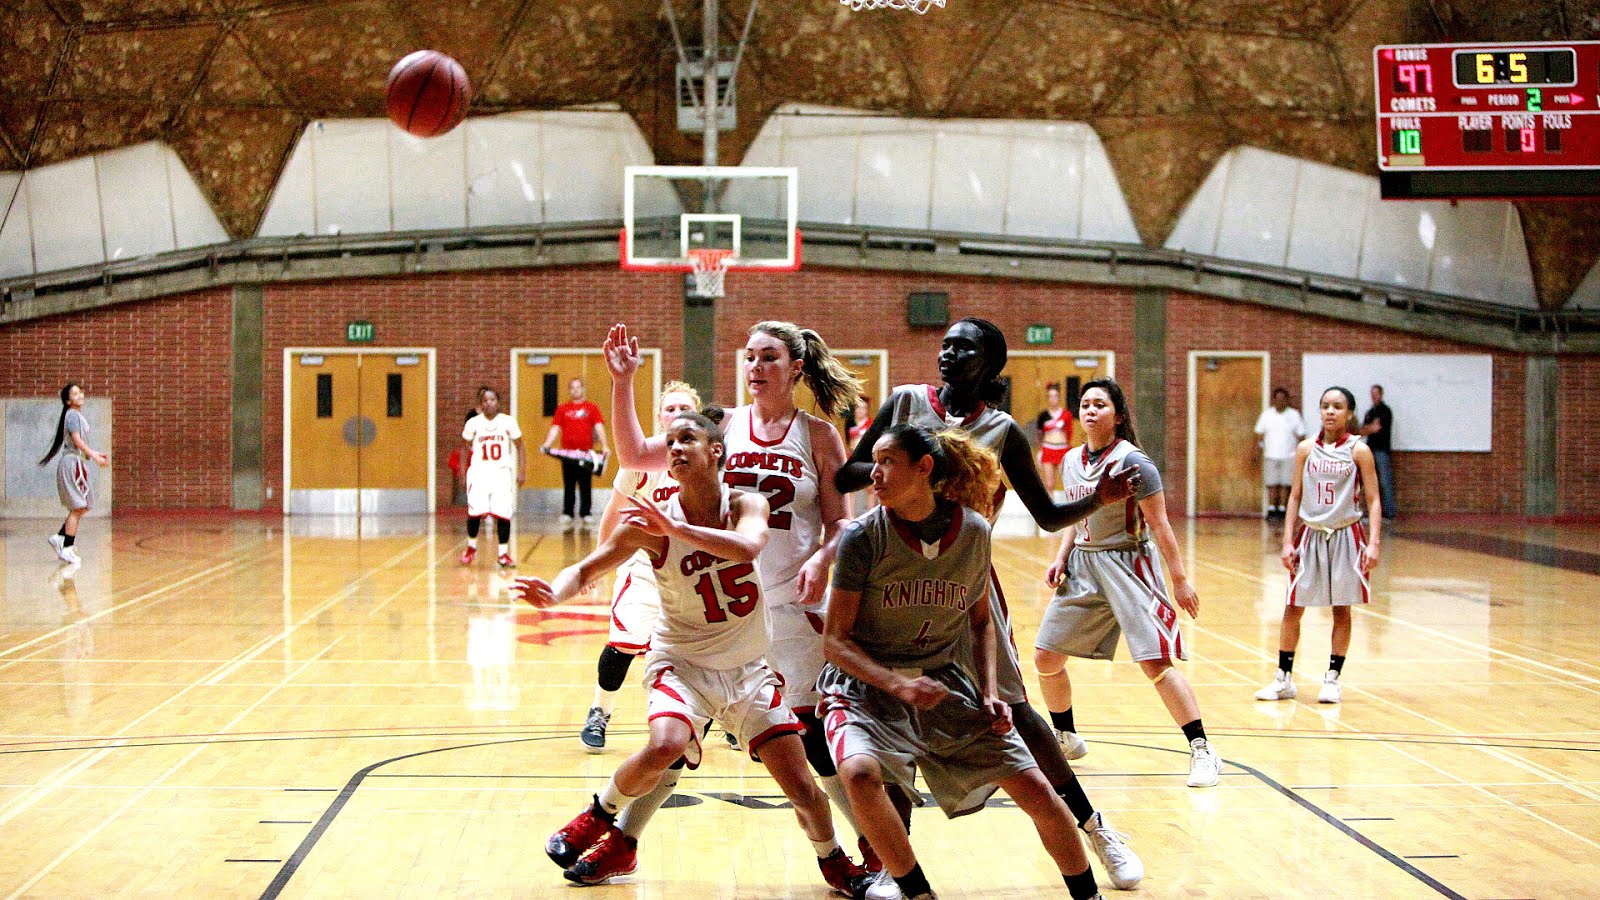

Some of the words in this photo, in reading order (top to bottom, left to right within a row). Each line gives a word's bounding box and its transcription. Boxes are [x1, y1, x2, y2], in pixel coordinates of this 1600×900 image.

[1398, 64, 1432, 93] 97
[1390, 97, 1436, 112] COMETS
[1488, 94, 1519, 105] PERIOD
[1527, 88, 1541, 112] 2
[1390, 117, 1421, 130] FOULS
[1458, 114, 1492, 130] PLAYER
[1502, 114, 1535, 130] POINTS
[1543, 113, 1572, 129] FOULS
[1399, 130, 1421, 154] 10
[1520, 128, 1535, 152] 0
[481, 443, 502, 461] 10
[726, 452, 803, 478] COMETS
[1317, 481, 1335, 505] 15
[694, 562, 759, 624] 15
[882, 579, 967, 612] KNIGHTS
